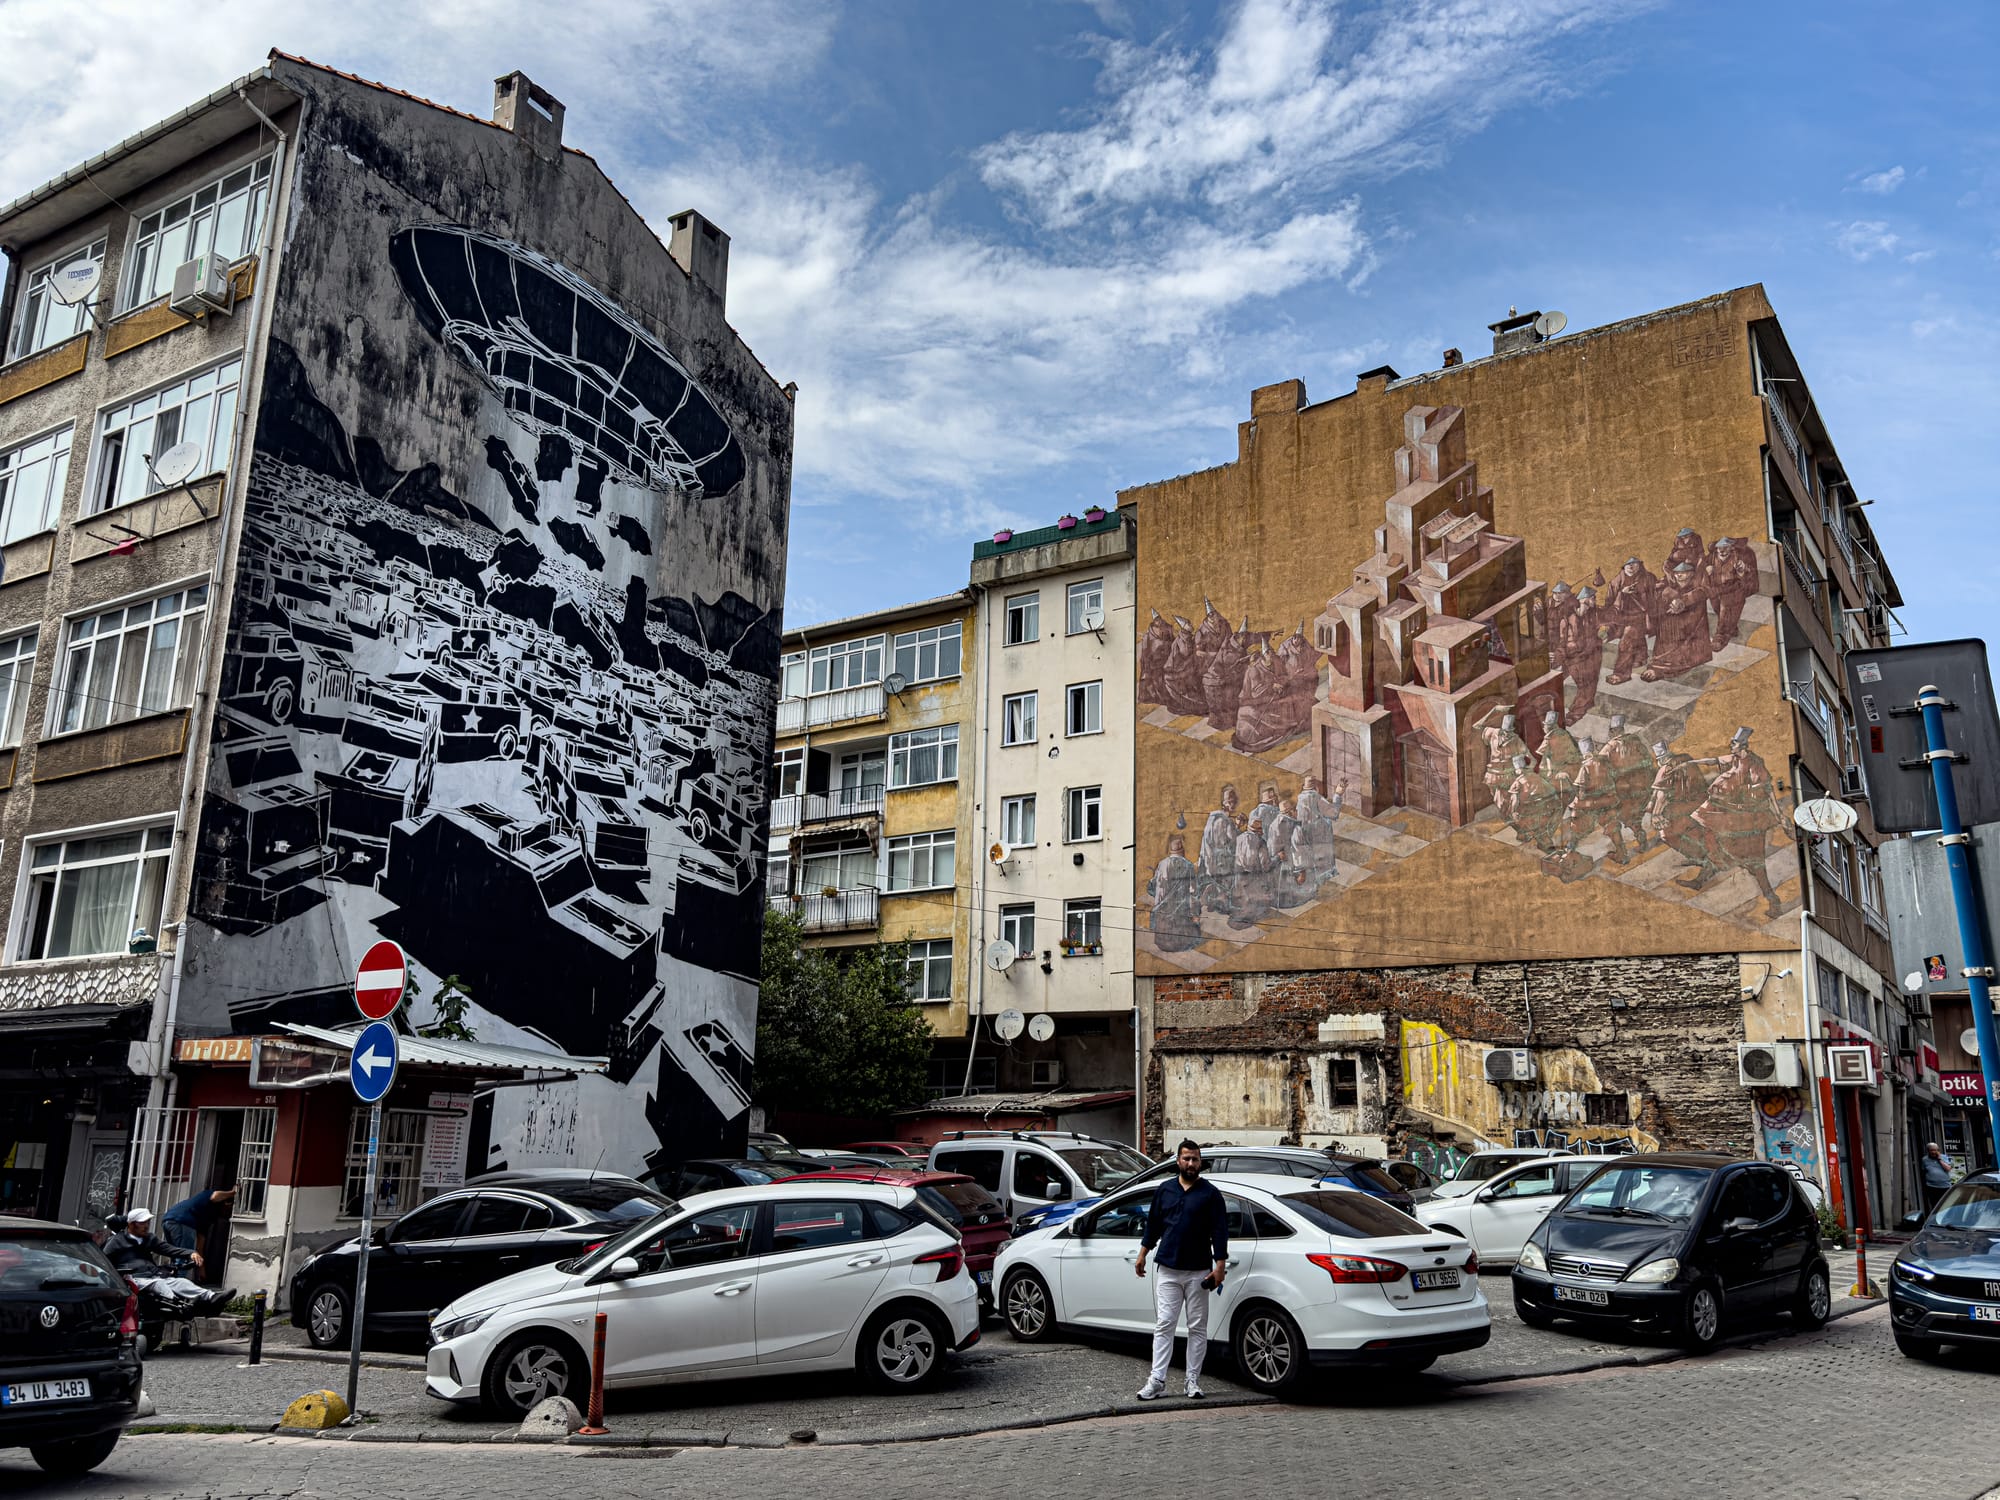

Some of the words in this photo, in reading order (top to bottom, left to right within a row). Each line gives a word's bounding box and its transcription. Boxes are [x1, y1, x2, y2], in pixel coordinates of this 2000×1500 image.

[1840, 1055, 1862, 1077] E
[1557, 1287, 1568, 1298] 34
[1984, 1281, 2000, 1297] FIA
[1976, 1307, 1990, 1319] 34
[9, 1386, 26, 1403] 34
[33, 1384, 49, 1400] UA
[55, 1381, 85, 1398] 3483
